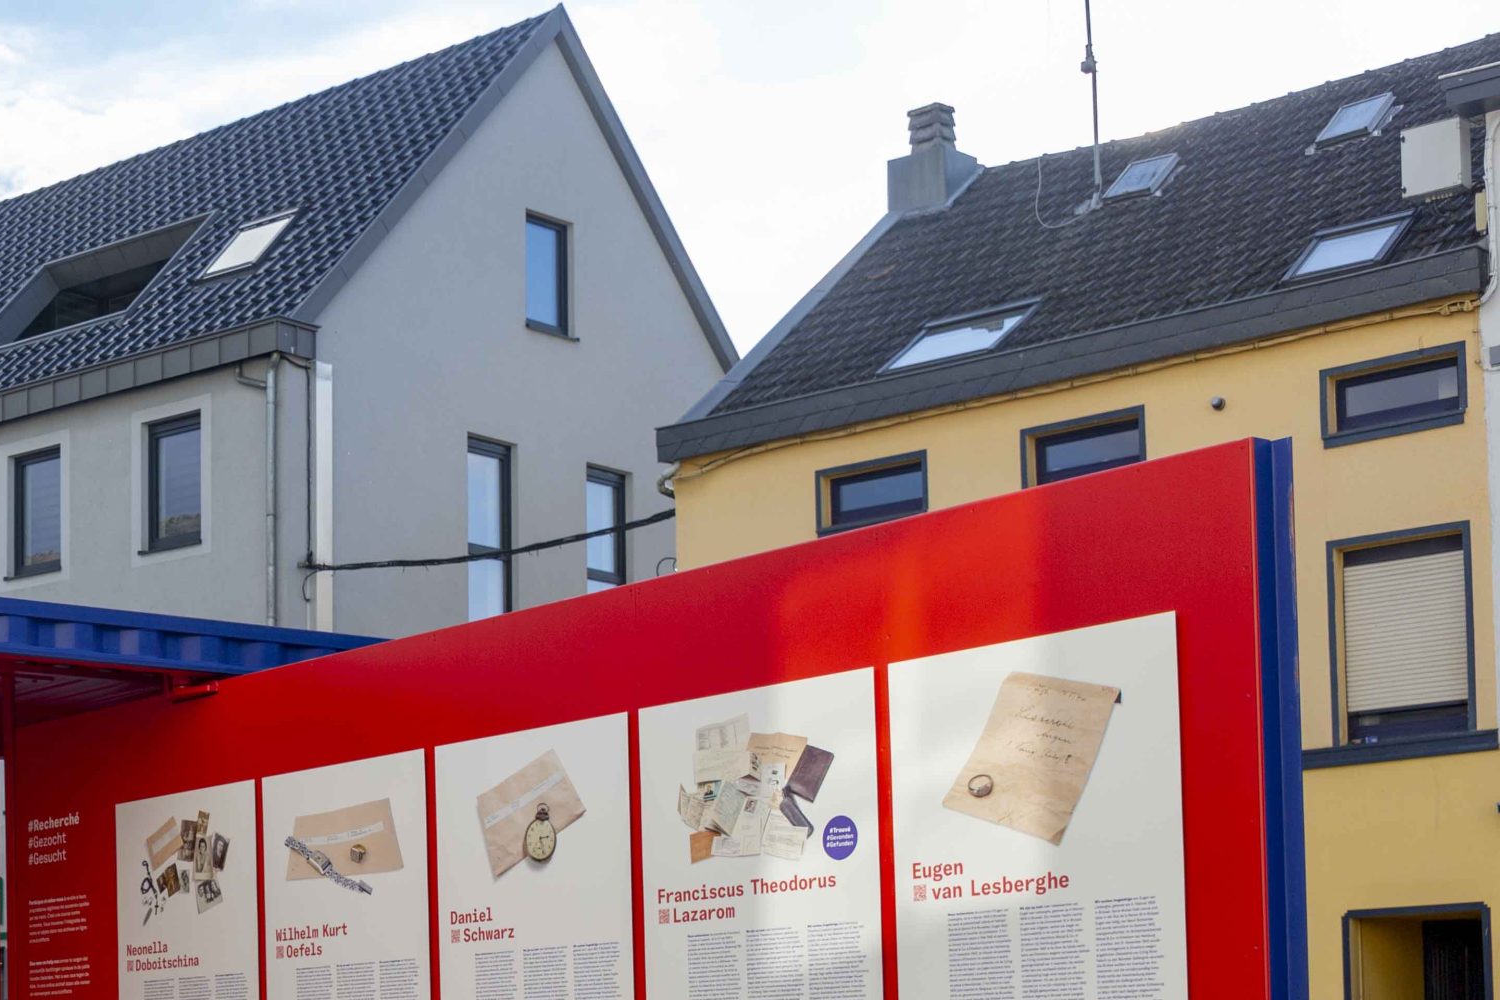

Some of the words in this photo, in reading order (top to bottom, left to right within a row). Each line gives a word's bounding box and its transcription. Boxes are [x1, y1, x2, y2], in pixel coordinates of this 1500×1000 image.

[28, 812, 79, 831] #Recherché
[829, 826, 851, 834] #Trouvé
[28, 833, 66, 848] #Gezocht
[29, 850, 66, 865] #Gesucht
[913, 863, 963, 881] Eugen
[658, 885, 743, 904] Franciscus
[750, 875, 836, 895] Theodorus
[932, 886, 962, 899] van
[972, 872, 1069, 896] Lesberghe
[451, 907, 492, 925] Daniel
[674, 907, 735, 923] Lazarom
[276, 926, 318, 941] Wilhelm
[323, 924, 347, 937] Kurt
[464, 927, 514, 942] Schwarz
[127, 941, 167, 956] Neonella
[287, 943, 322, 958] Oefels
[135, 954, 199, 971] Doboitschina
